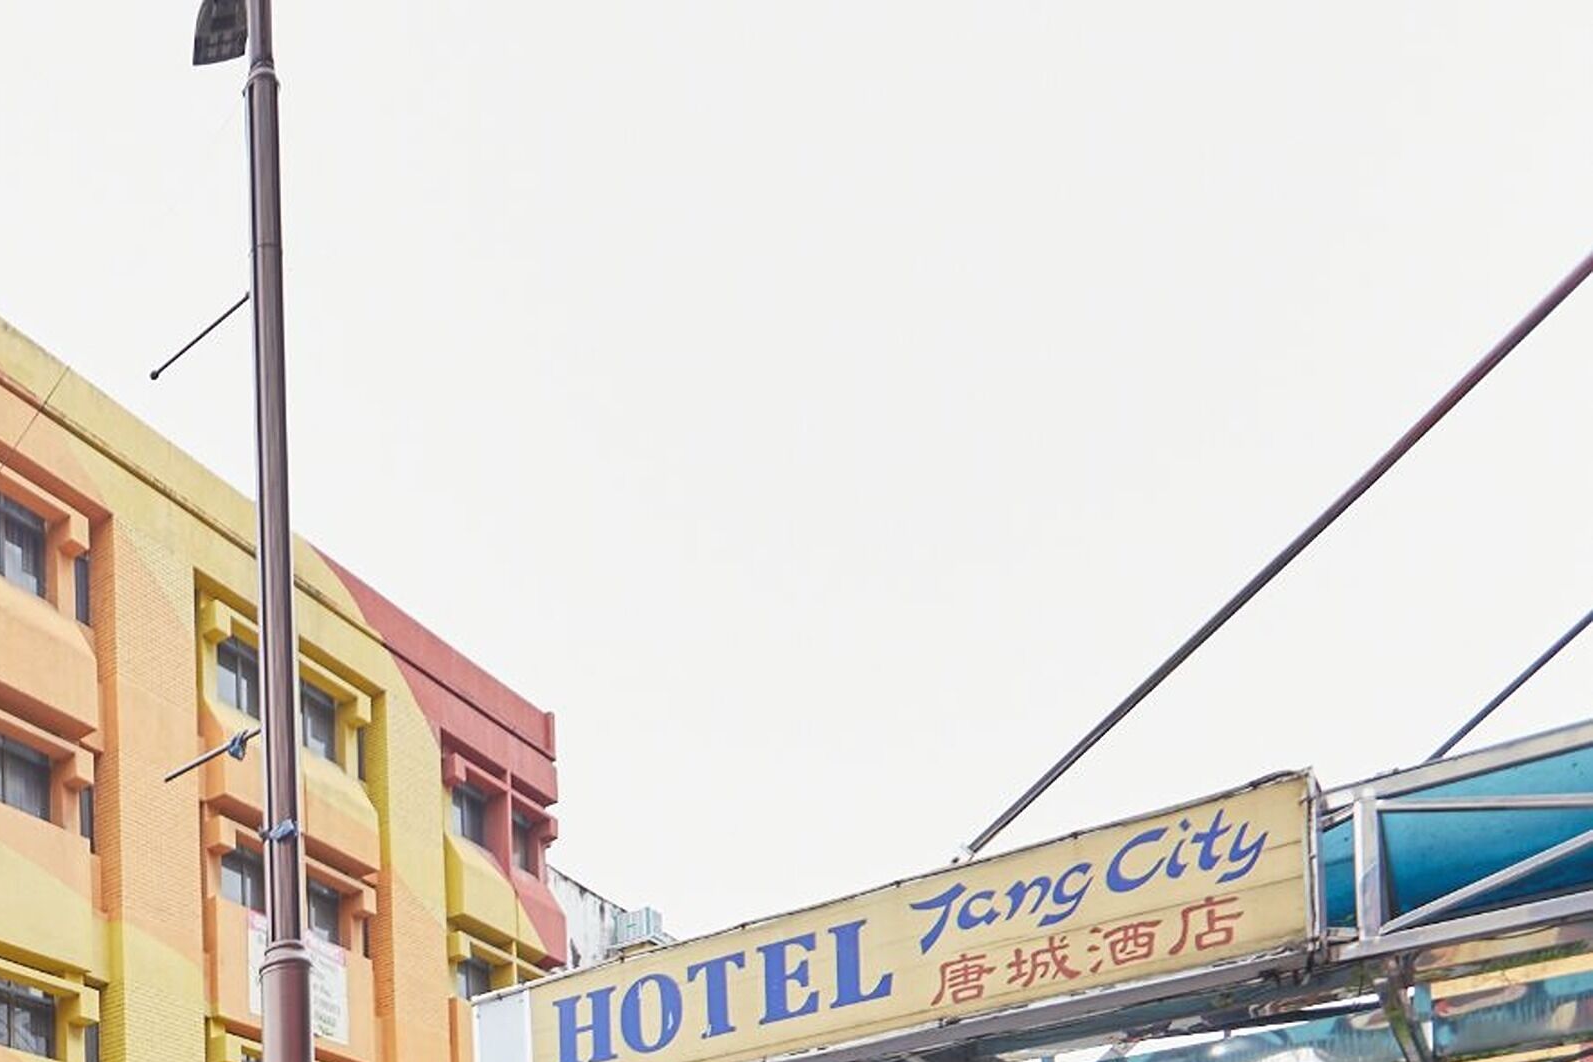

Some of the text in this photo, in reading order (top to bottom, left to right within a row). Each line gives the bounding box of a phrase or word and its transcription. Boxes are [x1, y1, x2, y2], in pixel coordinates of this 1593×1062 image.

[910, 808, 1269, 954] Tang City
[931, 896, 1244, 1006] 唐城酒店
